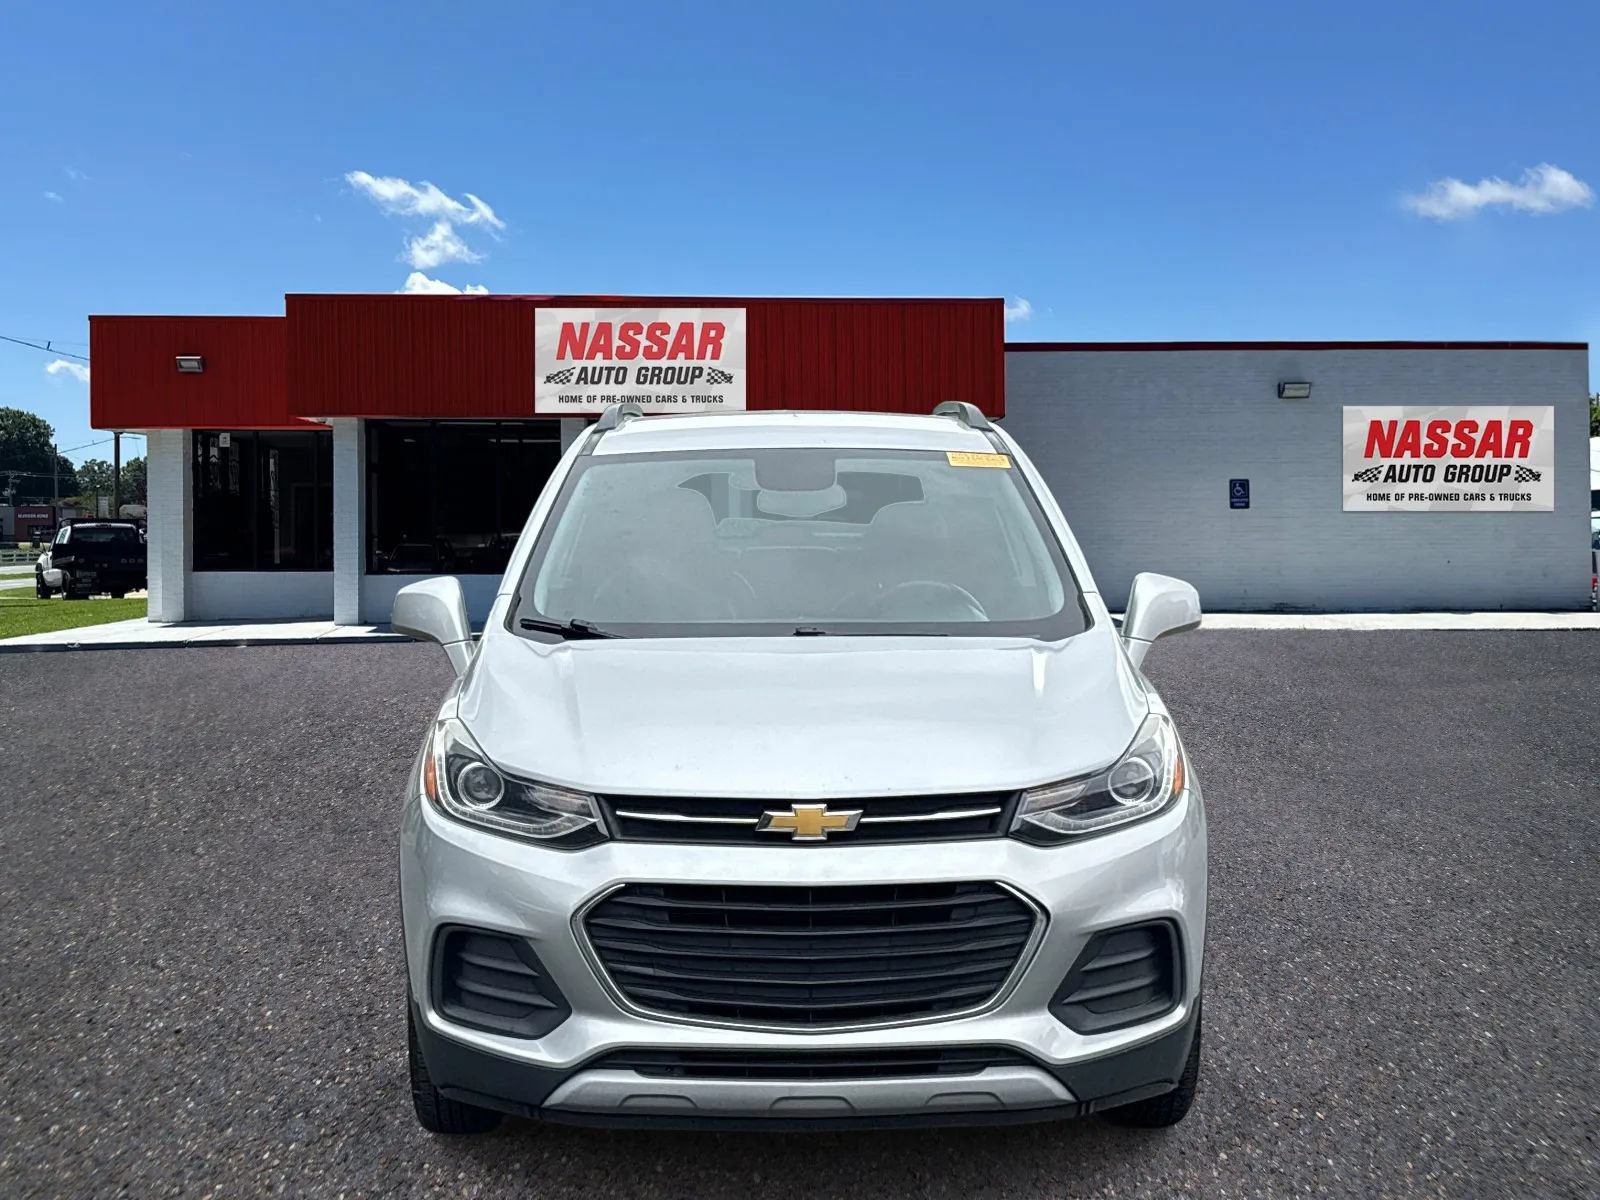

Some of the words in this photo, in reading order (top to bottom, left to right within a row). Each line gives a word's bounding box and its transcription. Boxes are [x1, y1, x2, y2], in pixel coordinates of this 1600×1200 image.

[555, 321, 726, 361] NASSAR
[575, 366, 628, 385] AUTO
[635, 366, 704, 385] GROUP
[558, 395, 583, 403] HOME
[586, 395, 597, 403] OF
[600, 395, 652, 403] PRE-OWNED
[655, 395, 678, 403] CARS
[681, 395, 687, 403] &
[690, 395, 724, 403] TRUCKS
[1363, 419, 1534, 459] NASSAR
[1383, 464, 1436, 483] AUTO
[1443, 464, 1512, 483] GROUP
[1366, 493, 1391, 501] HOME
[1394, 493, 1405, 501] OF
[1408, 493, 1460, 501] PRE-OWNED
[1463, 493, 1486, 501] CARS
[1489, 493, 1495, 501] &
[1499, 493, 1532, 501] TRUCKS
